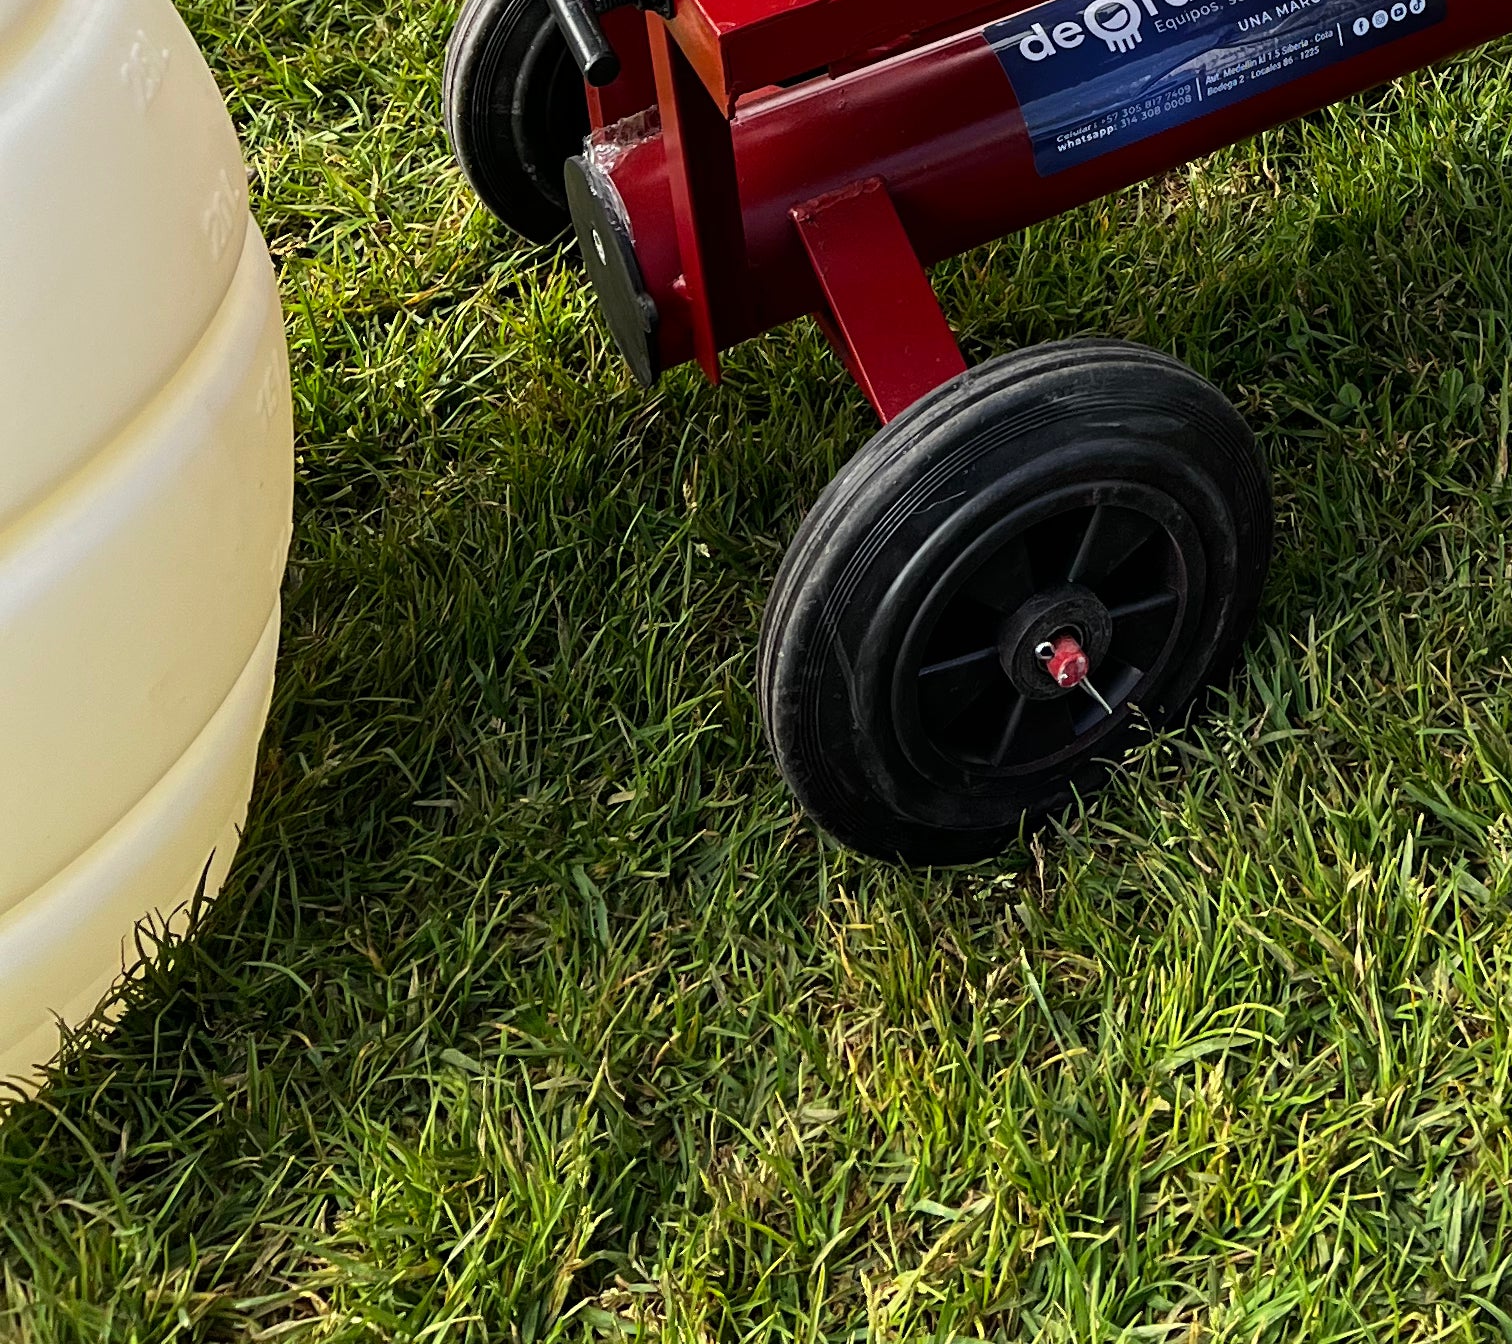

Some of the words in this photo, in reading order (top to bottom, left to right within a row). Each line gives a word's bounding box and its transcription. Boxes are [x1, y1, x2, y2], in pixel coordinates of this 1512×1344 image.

[1237, 10, 1273, 32] UNA
[1314, 29, 1334, 43] Cota
[1207, 78, 1238, 96] Bodega
[1238, 74, 1245, 84] 2
[1250, 60, 1282, 80] Locales
[1299, 45, 1320, 60] 1225
[1144, 95, 1163, 109] 817
[1165, 84, 1192, 101] 7409
[1120, 115, 1138, 129] 314
[1141, 106, 1161, 121] 308
[1164, 94, 1192, 111] 0008
